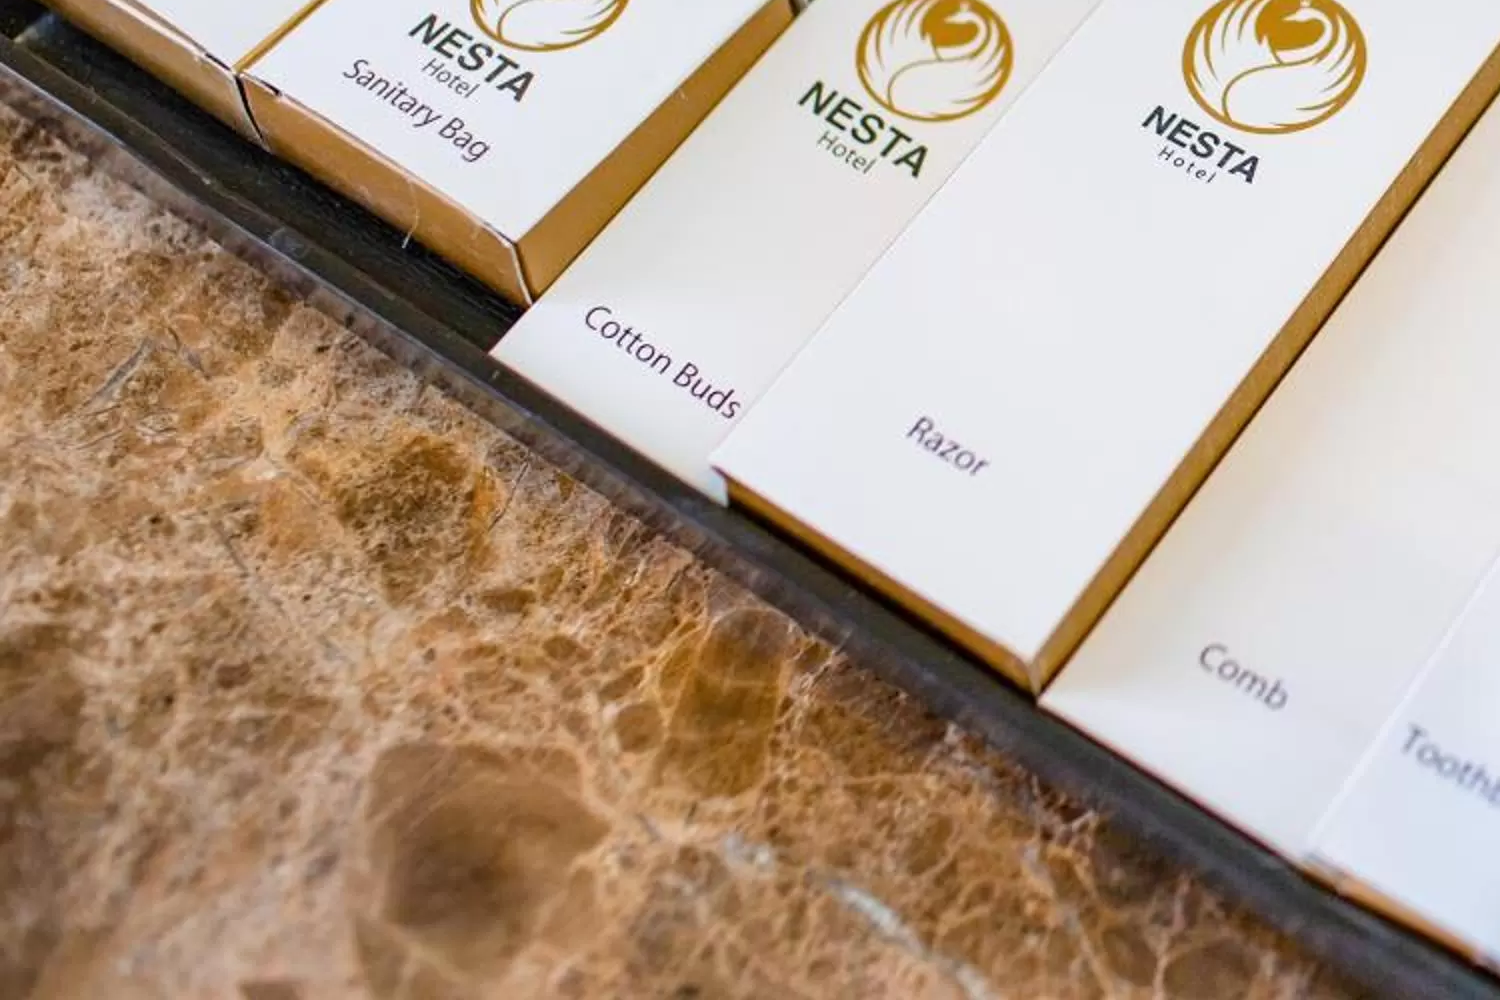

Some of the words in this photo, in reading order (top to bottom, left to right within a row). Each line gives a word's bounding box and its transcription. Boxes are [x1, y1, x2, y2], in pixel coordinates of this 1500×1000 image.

[409, 12, 535, 102] NESTA
[421, 57, 480, 99] Hotel
[342, 58, 441, 128] Sanitary
[439, 116, 490, 163] Bag
[798, 81, 935, 178] NESTA
[1142, 105, 1262, 185] NESTA
[816, 131, 877, 175] Hotel
[1157, 146, 1217, 184] Hotel
[584, 305, 672, 376] Cotton
[673, 362, 742, 421] Buds
[905, 416, 990, 477] Razor
[1198, 643, 1289, 711] Comb
